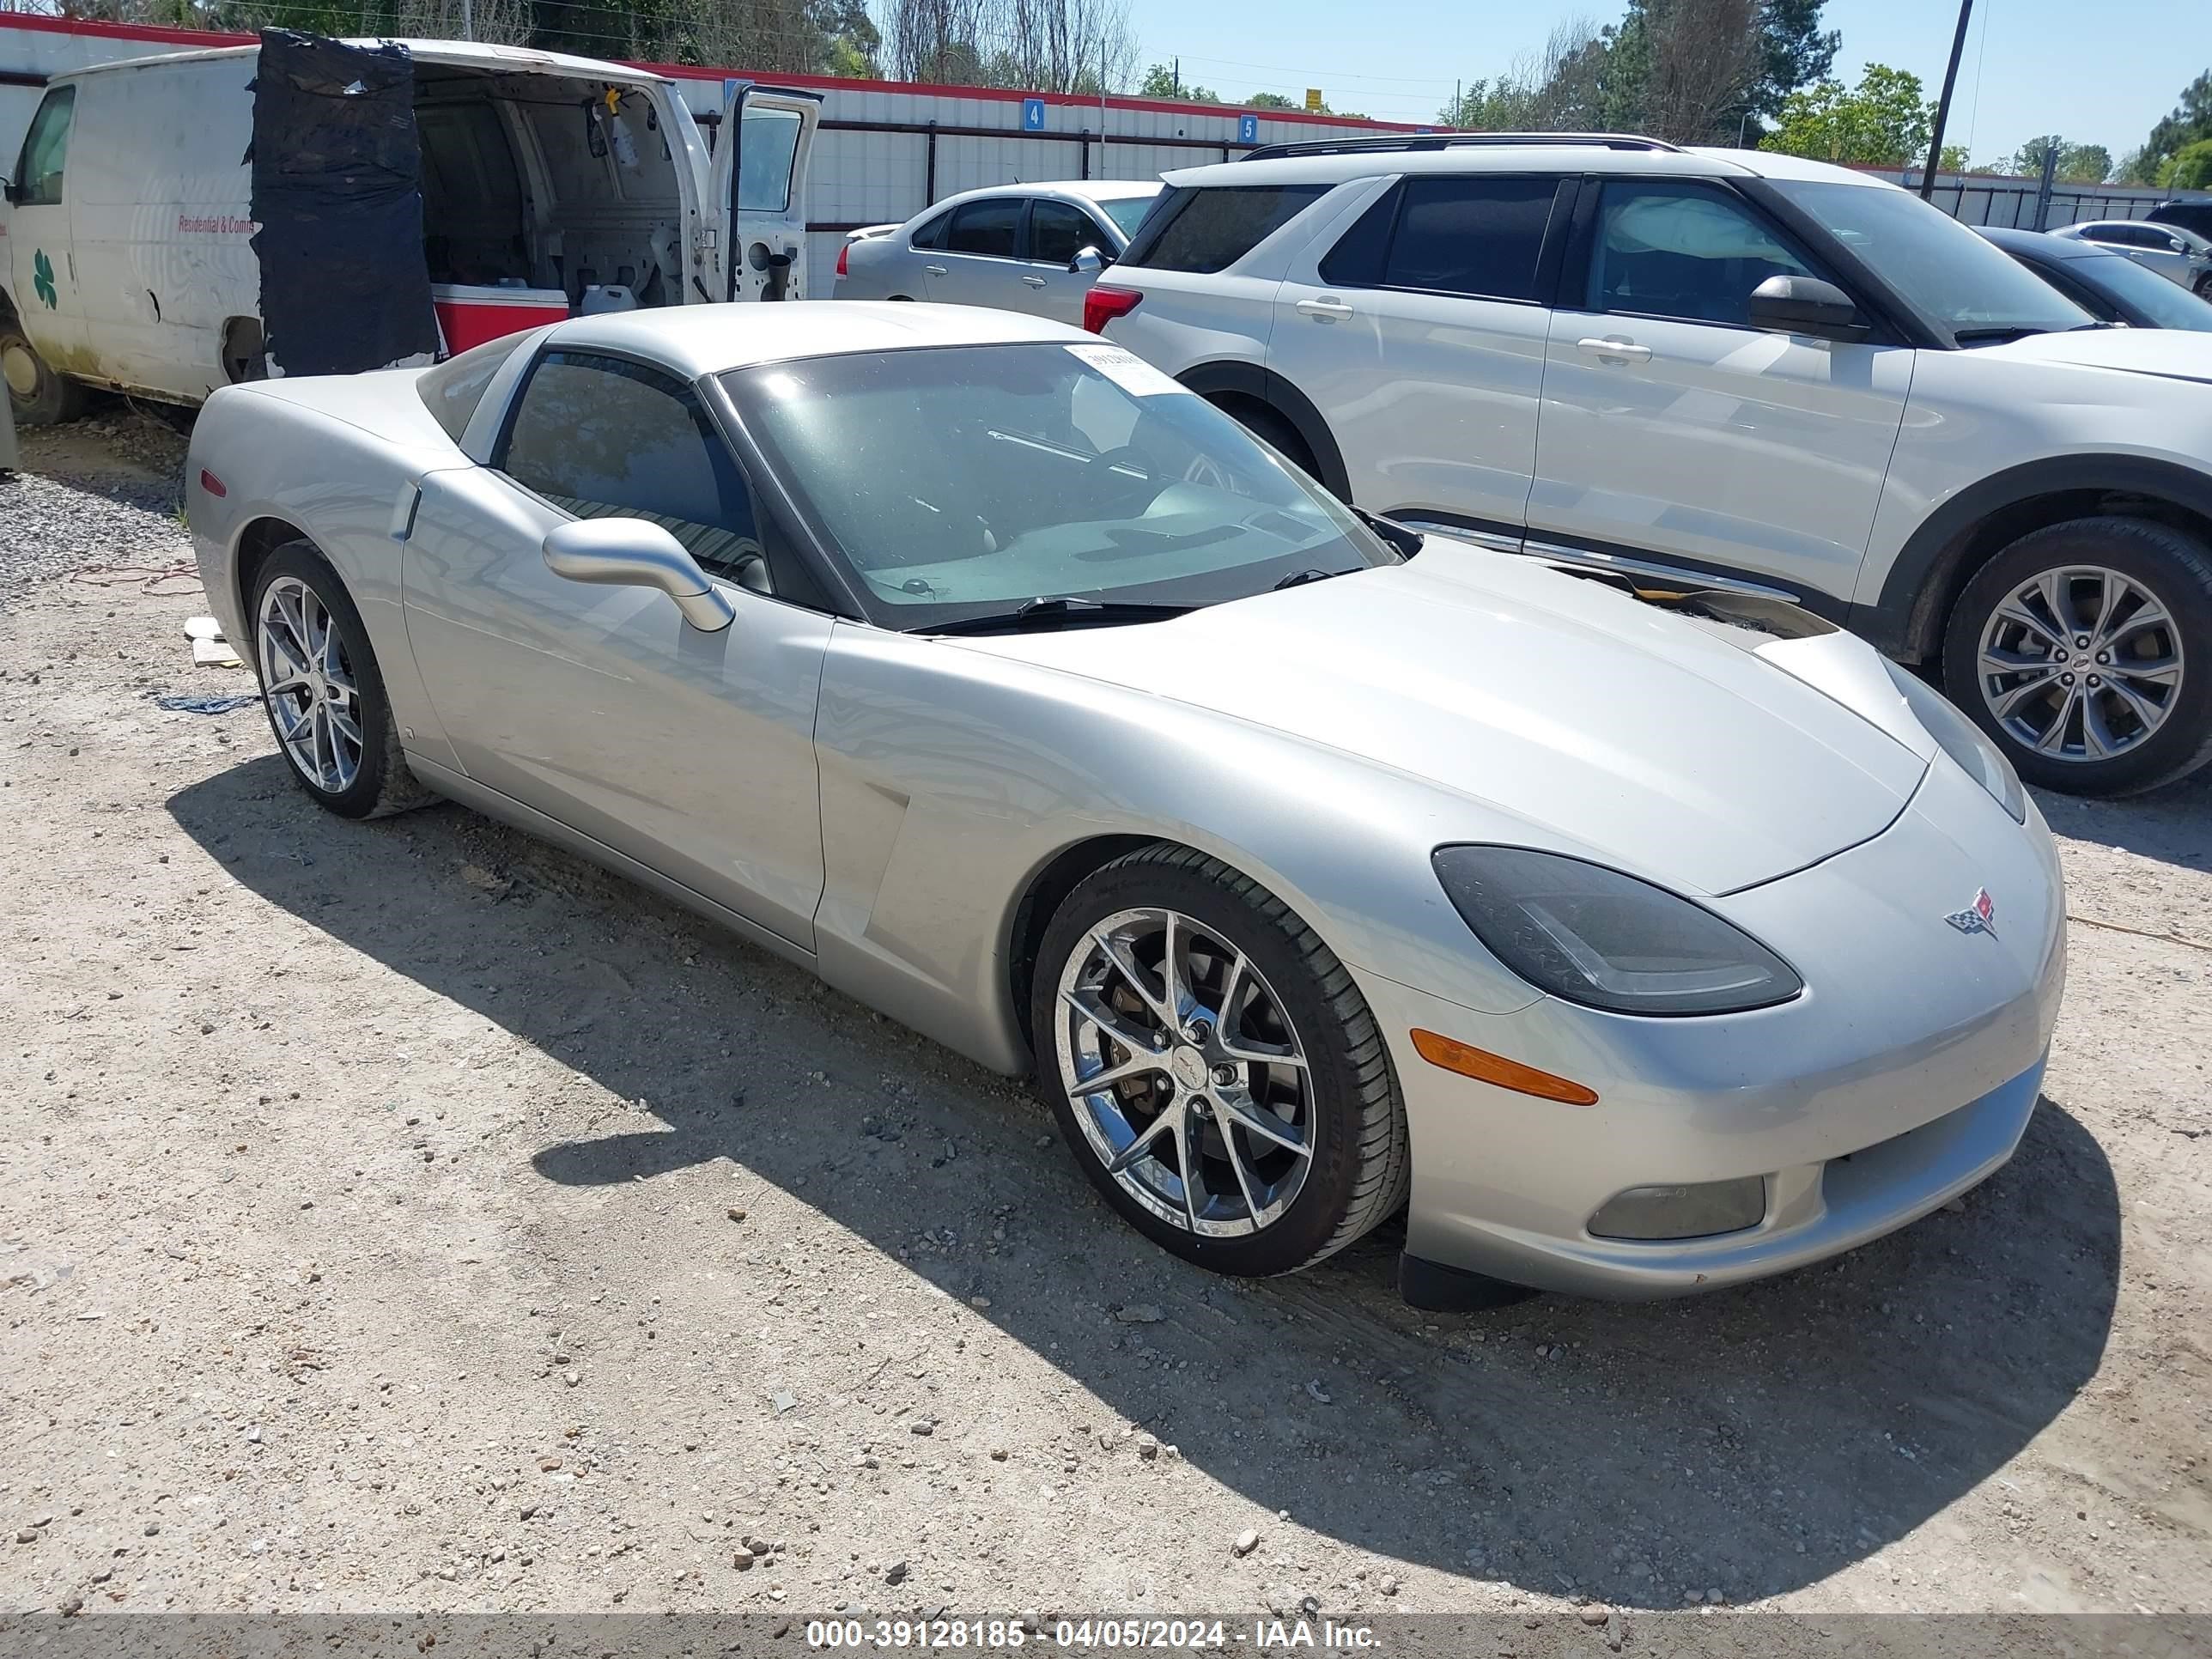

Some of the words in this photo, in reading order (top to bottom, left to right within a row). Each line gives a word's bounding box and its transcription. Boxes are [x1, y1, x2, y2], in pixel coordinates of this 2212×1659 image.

[1030, 105, 1039, 125] 4
[1245, 120, 1252, 138] 5
[179, 216, 220, 234] Residential
[221, 216, 227, 234] &
